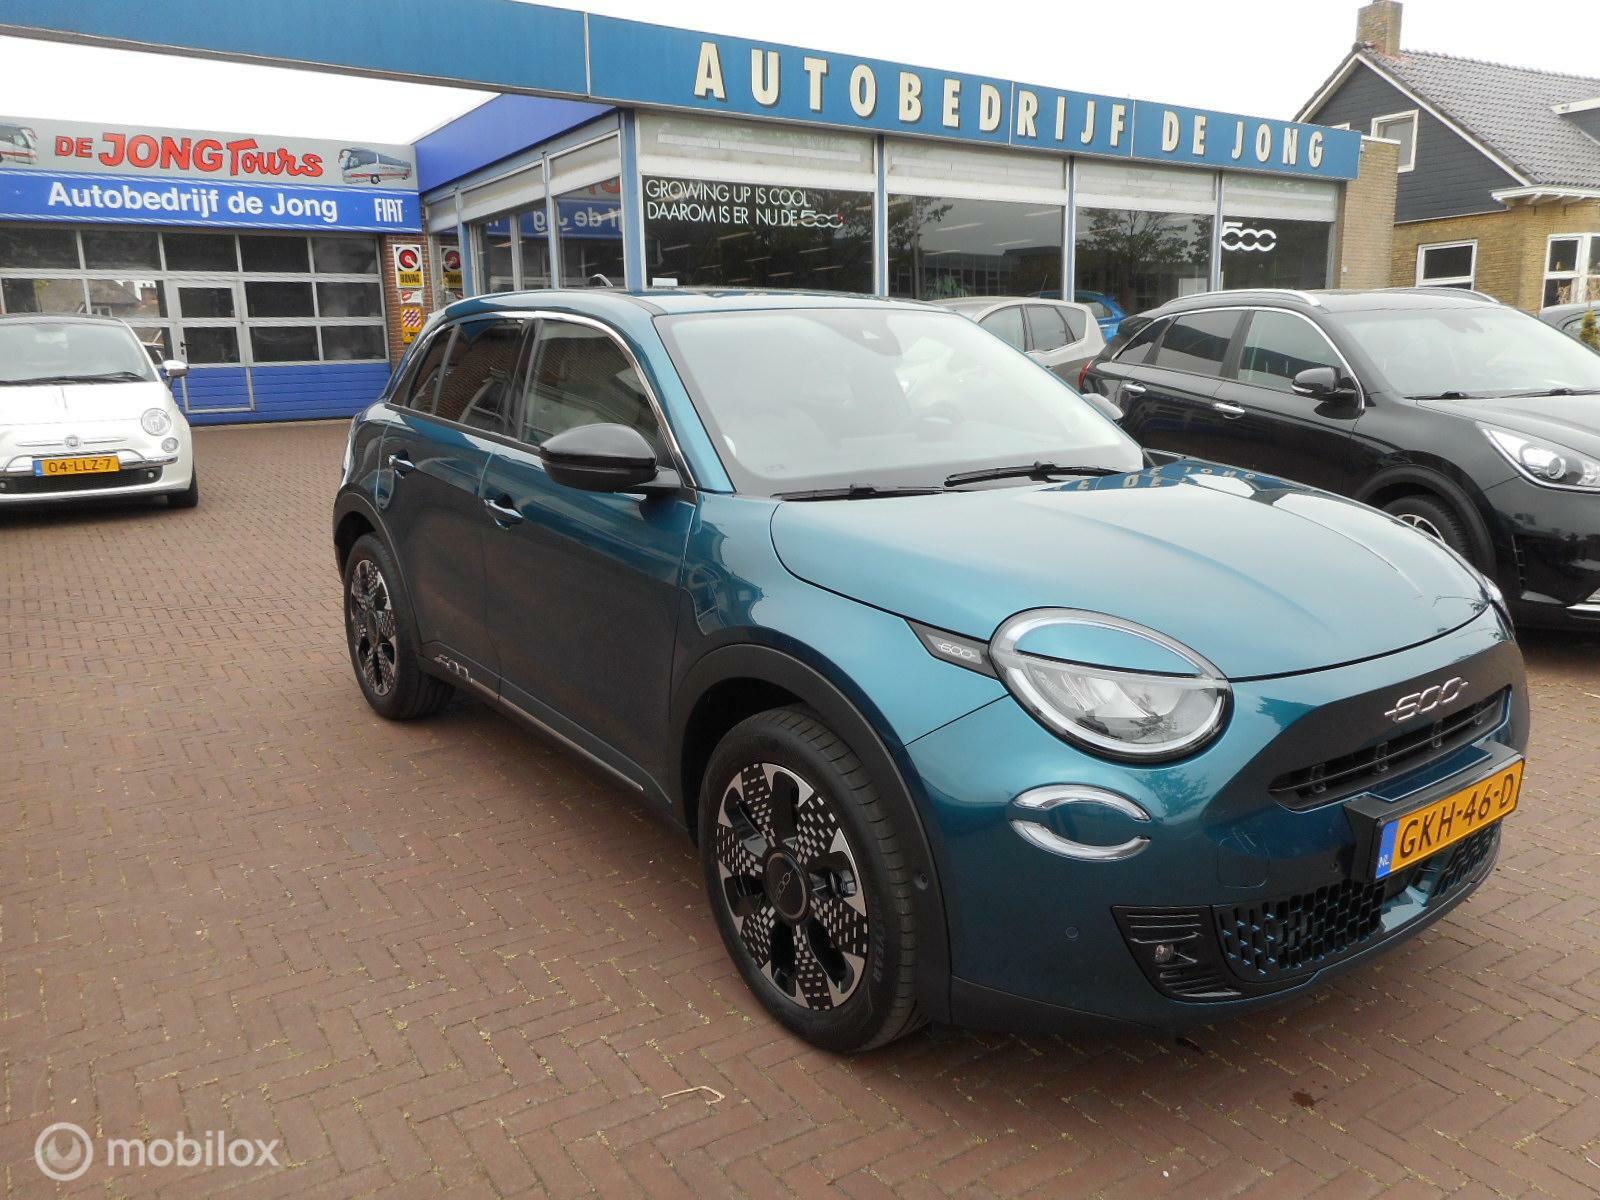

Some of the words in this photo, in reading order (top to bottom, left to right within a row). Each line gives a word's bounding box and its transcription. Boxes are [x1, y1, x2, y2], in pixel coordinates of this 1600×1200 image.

[694, 42, 1126, 147] AUTOBEDRIJF
[1162, 110, 1207, 156] DE
[1231, 121, 1323, 168] JONG
[55, 135, 94, 159] DE
[98, 132, 225, 174] JONG
[226, 137, 325, 178] Tours
[48, 181, 219, 218] Autobedrijf
[227, 190, 263, 216] de
[270, 194, 337, 224] Jong
[646, 179, 730, 202] GROWING
[733, 186, 751, 203] UP
[755, 187, 767, 205] IS
[769, 188, 812, 208] COOL
[374, 197, 404, 223] FIAT
[646, 201, 717, 224] DAAROM
[719, 206, 731, 224] IS
[733, 207, 749, 225] ER
[756, 209, 778, 226] NU
[781, 210, 798, 228] DE
[1221, 221, 1277, 252] 500
[48, 459, 111, 473] 04-LLZ-7
[1399, 773, 1515, 858] GKH-46-D
